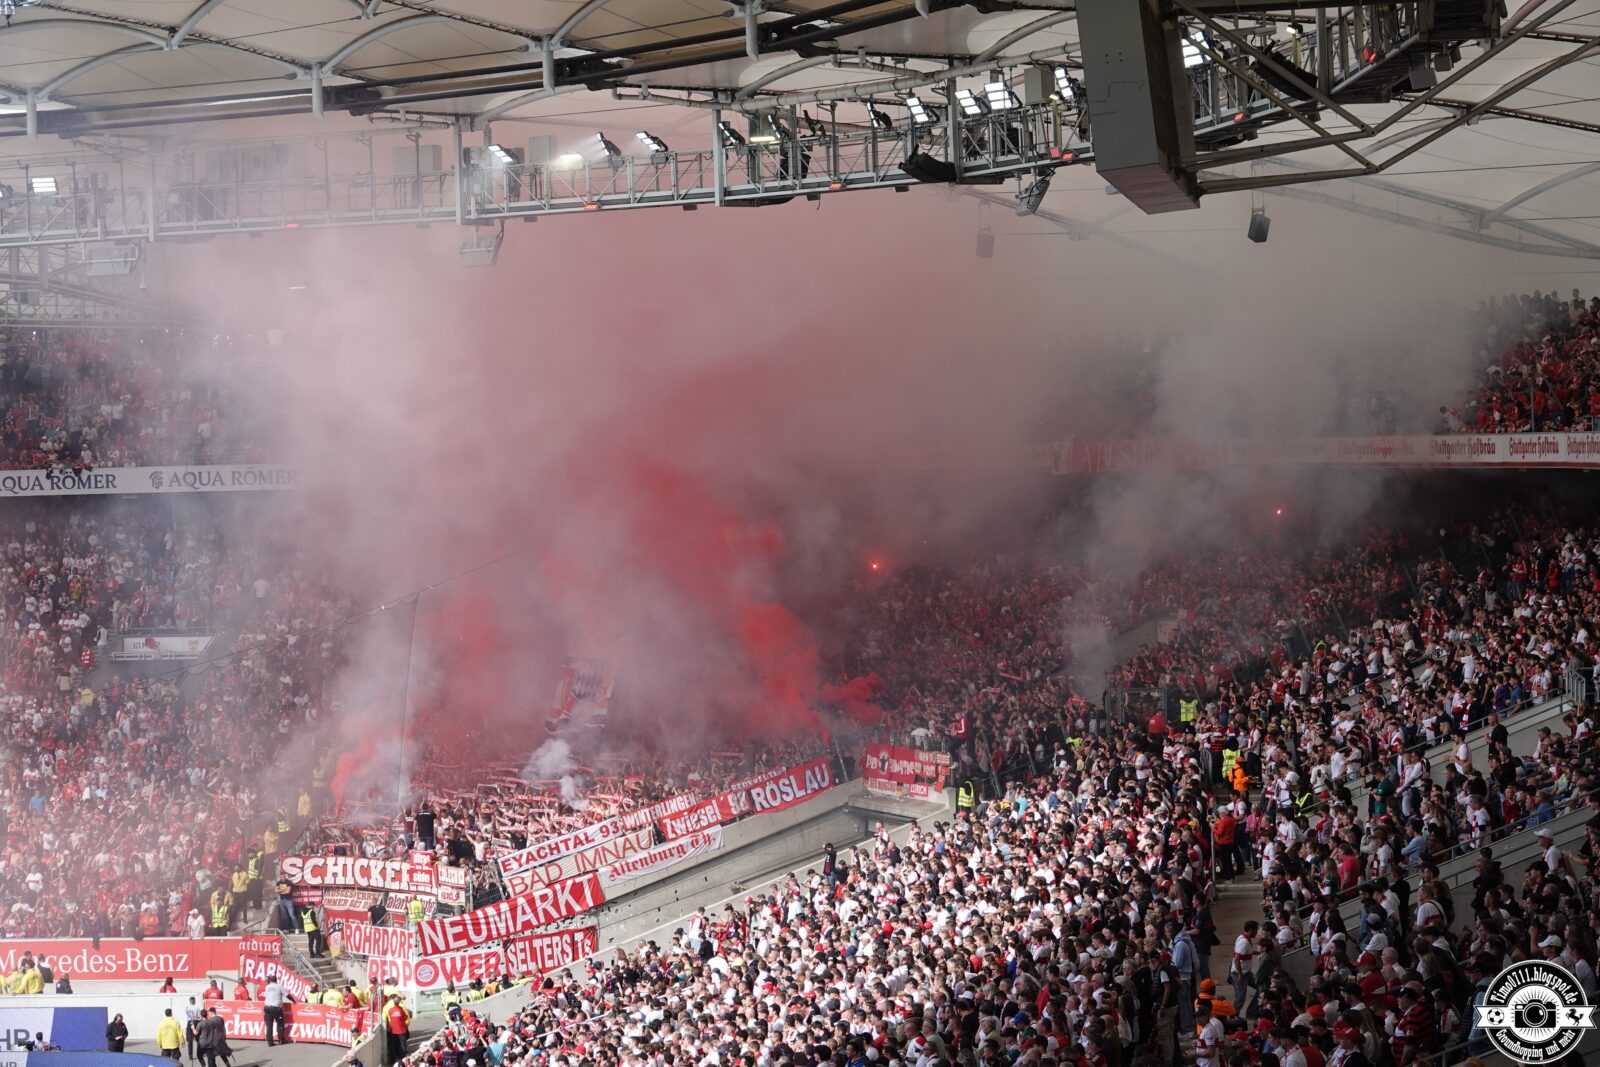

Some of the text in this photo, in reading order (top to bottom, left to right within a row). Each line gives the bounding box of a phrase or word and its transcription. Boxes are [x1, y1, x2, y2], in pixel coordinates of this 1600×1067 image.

[0, 471, 117, 494] QUA RÖMER
[168, 466, 299, 490] AQUA RÖMER
[751, 763, 830, 812] RÖSLAU
[623, 792, 697, 829] WINTERLINGEN
[663, 803, 722, 840] Zwiesel
[500, 821, 620, 873] EYACHTAL 93
[508, 827, 652, 896] BAD IMNAU
[609, 841, 687, 882] Altenburg
[420, 874, 594, 954] NEUMARKT
[345, 924, 414, 959] ROHRDORF
[508, 935, 572, 975] SELTERS
[368, 958, 400, 985] RED
[402, 951, 502, 987] POWER
